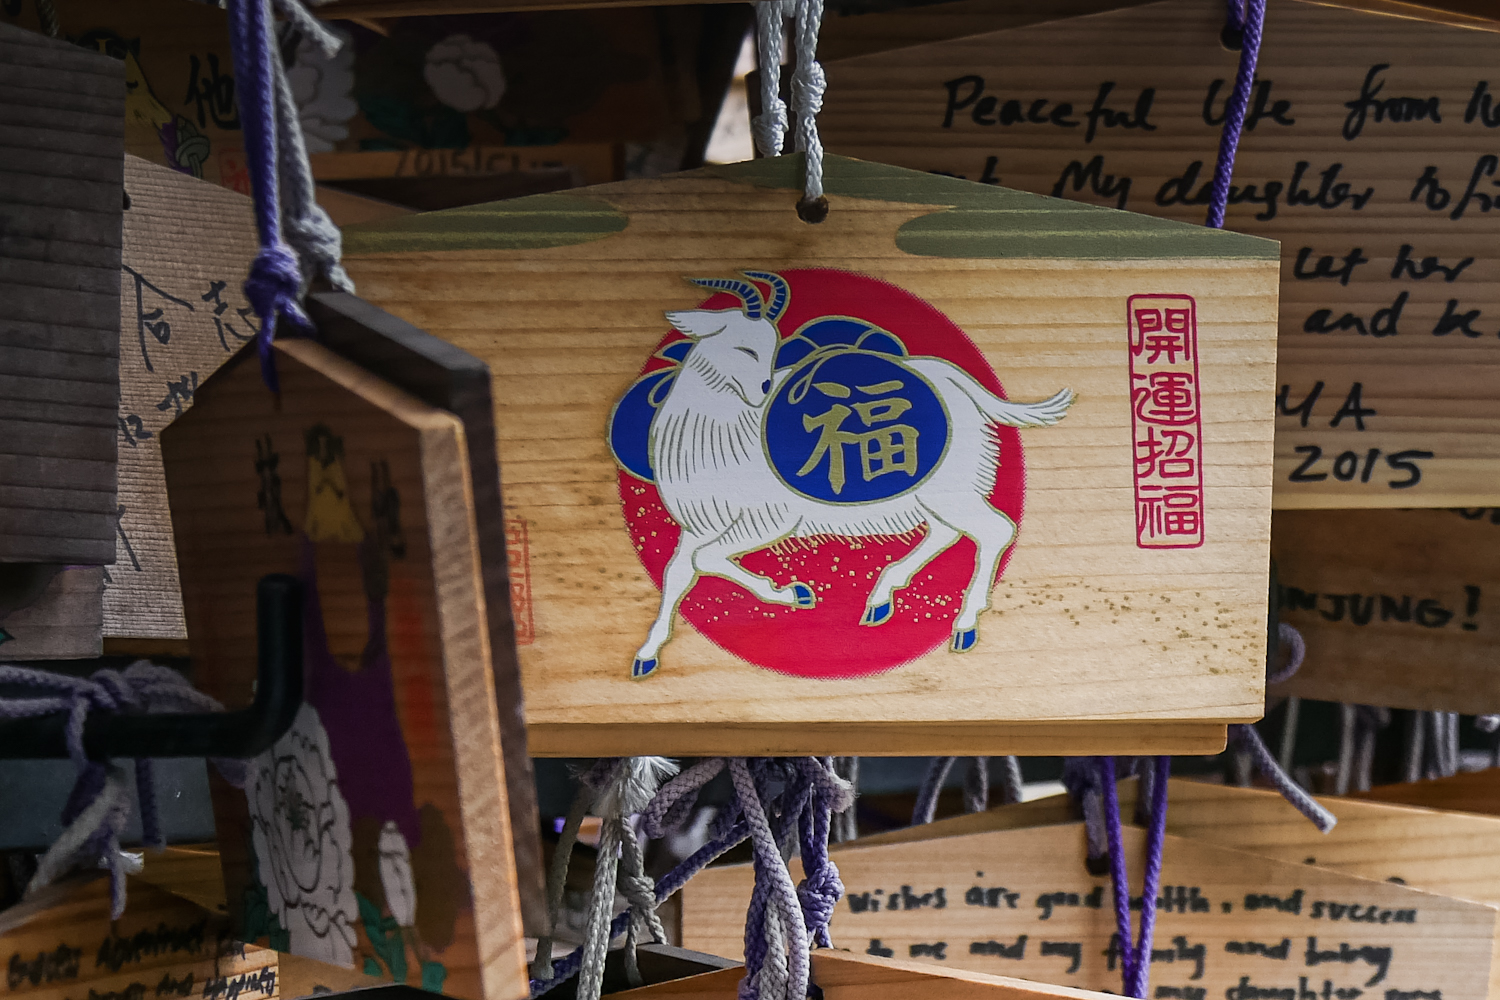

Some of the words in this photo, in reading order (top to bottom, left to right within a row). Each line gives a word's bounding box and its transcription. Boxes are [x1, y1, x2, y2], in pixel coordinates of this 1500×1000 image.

[942, 75, 1157, 143] Peaceful
[1342, 63, 1442, 140] from
[1303, 291, 1410, 338] and
[1432, 298, 1485, 338] be
[796, 379, 921, 496] 福
[1131, 307, 1200, 540] 開運招福
[1288, 444, 1434, 489] 2015
[969, 935, 1028, 960] and
[1040, 941, 1083, 973] my
